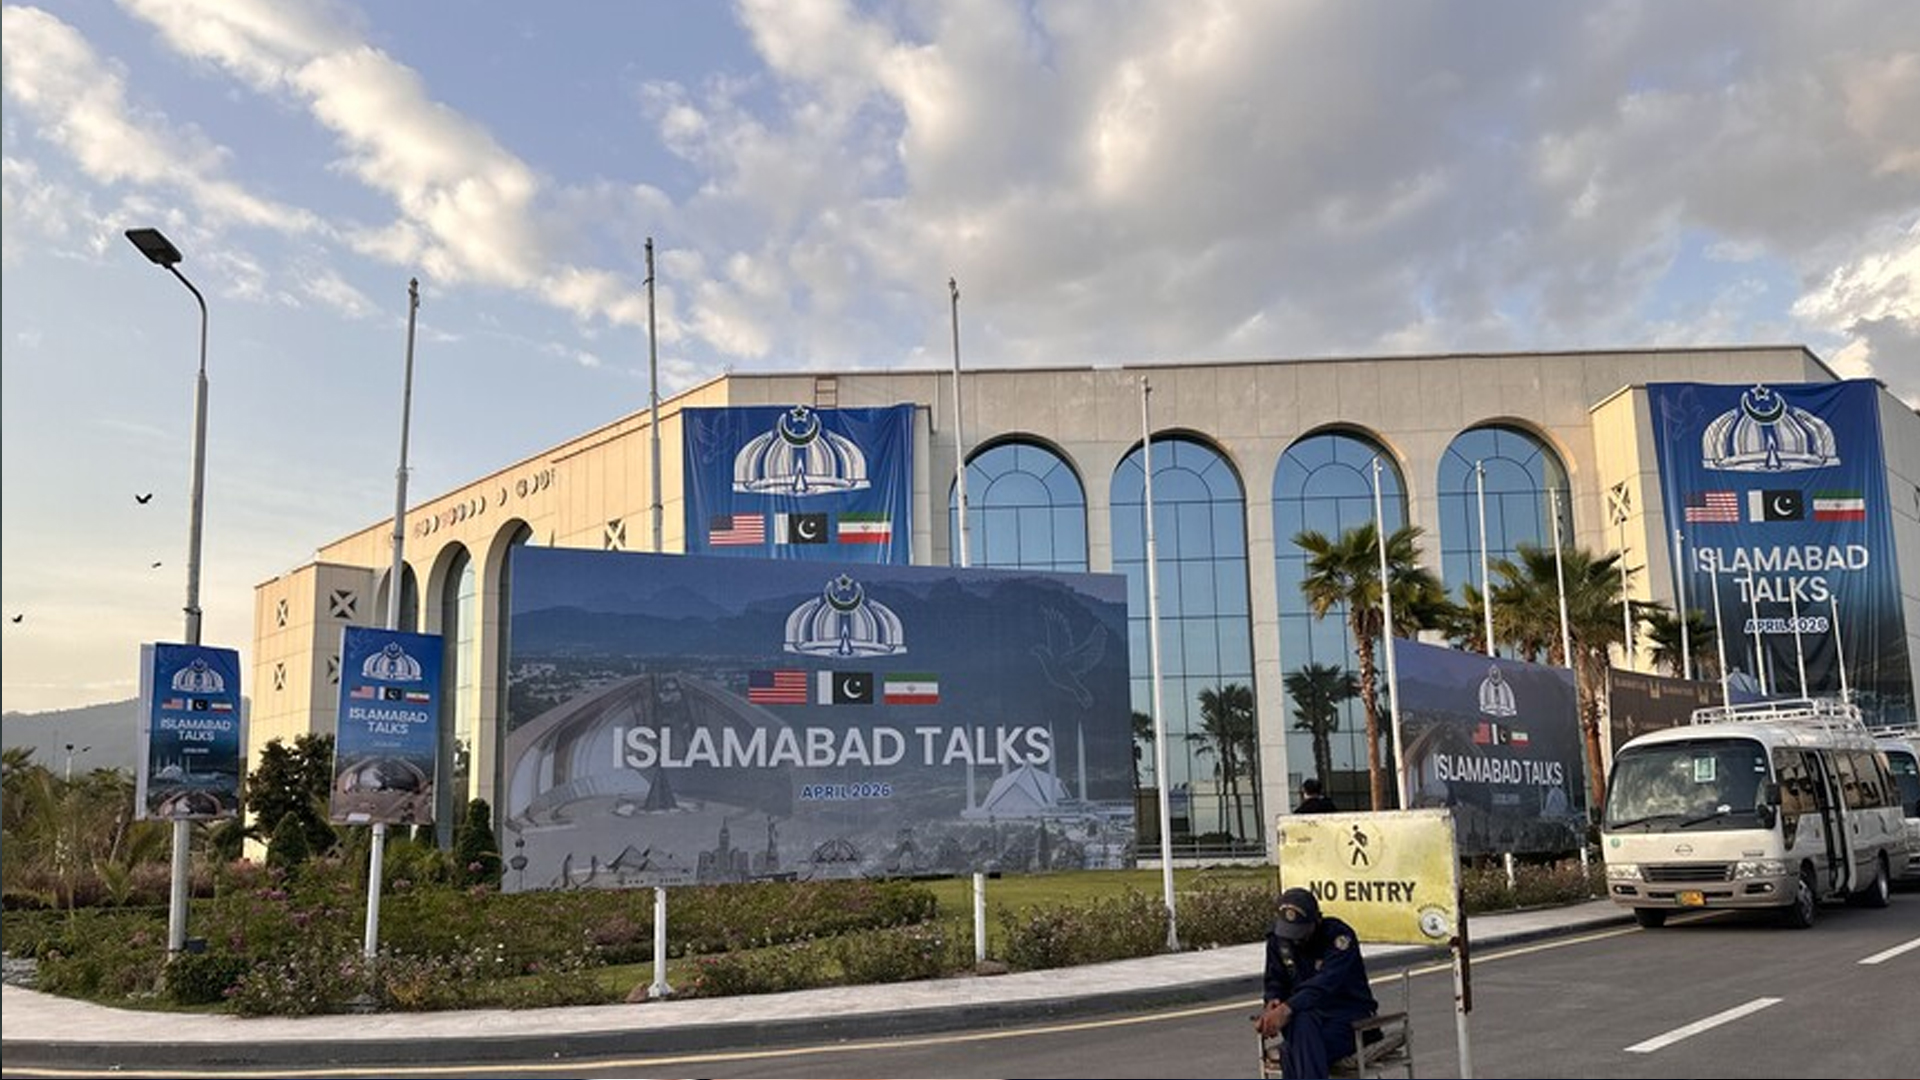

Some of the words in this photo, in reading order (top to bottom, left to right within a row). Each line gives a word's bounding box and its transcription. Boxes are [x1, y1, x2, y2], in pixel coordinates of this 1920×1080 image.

[1692, 545, 1868, 573] ISLAMABAD
[1734, 576, 1829, 603] TALKS
[1744, 618, 1787, 634] APRIL
[349, 707, 429, 723] ISLAMABAD
[160, 718, 231, 731] ISLAMABAD
[367, 720, 410, 735] TALKS
[178, 729, 215, 742] TALKS
[612, 726, 906, 769] ISLAMABAD
[914, 726, 1051, 766] TALKS
[1432, 753, 1521, 784] ISLAMABAD
[1522, 760, 1564, 786] TALKS
[801, 785, 847, 800] APRIL
[851, 783, 891, 799] 2026
[1309, 880, 1338, 902] NO
[1343, 880, 1417, 903] ENTRY
